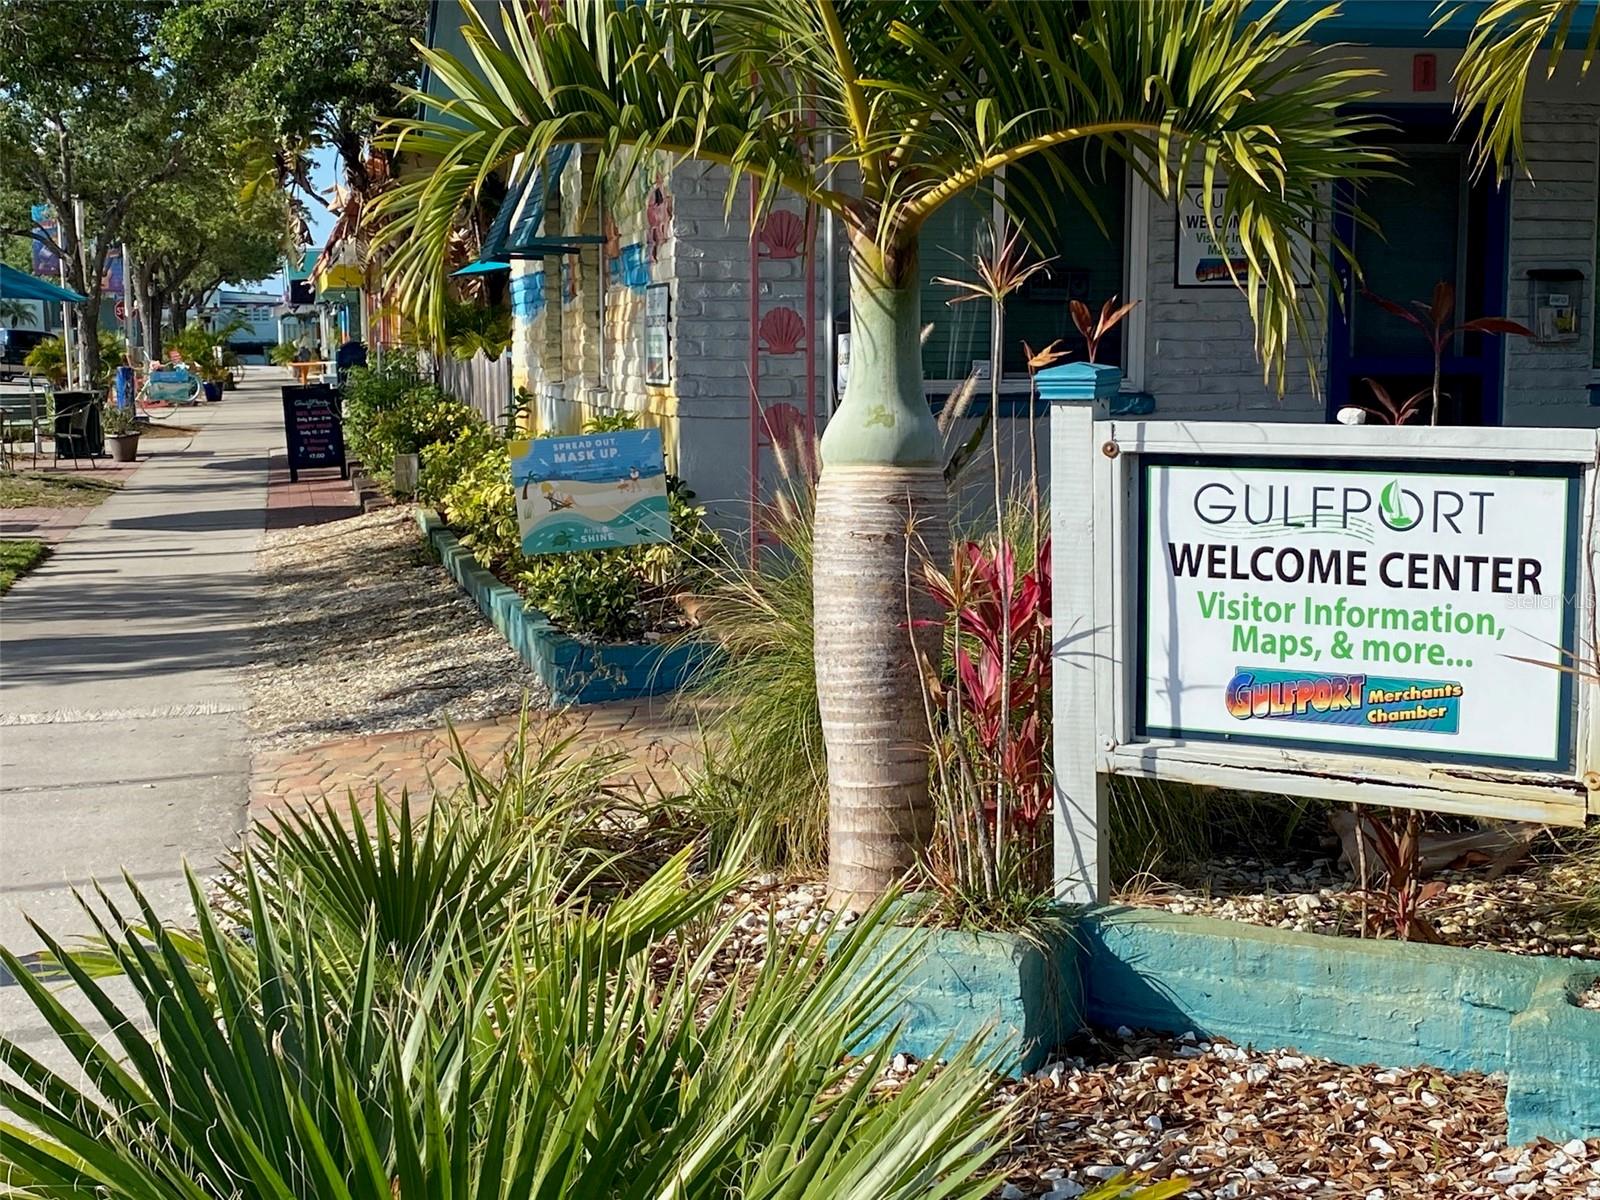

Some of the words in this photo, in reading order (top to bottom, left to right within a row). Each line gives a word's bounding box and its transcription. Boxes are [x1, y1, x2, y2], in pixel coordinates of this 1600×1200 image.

[553, 441, 592, 451] SPREAD
[554, 450, 596, 463] MASK
[600, 447, 621, 459] UP.
[1194, 481, 1494, 534] GULFPORT
[580, 532, 615, 543] SHINE
[1169, 543, 1367, 586] WELCOME
[1380, 552, 1542, 595] CENTER
[1198, 591, 1295, 623] Visitor
[1305, 597, 1504, 640] Information,
[1232, 625, 1321, 662] Maps,
[1331, 631, 1354, 660] &
[1362, 641, 1473, 668] more...
[1225, 672, 1366, 720] GULFPORT
[1367, 684, 1463, 704] Merchants
[1367, 705, 1447, 724] Chamber
